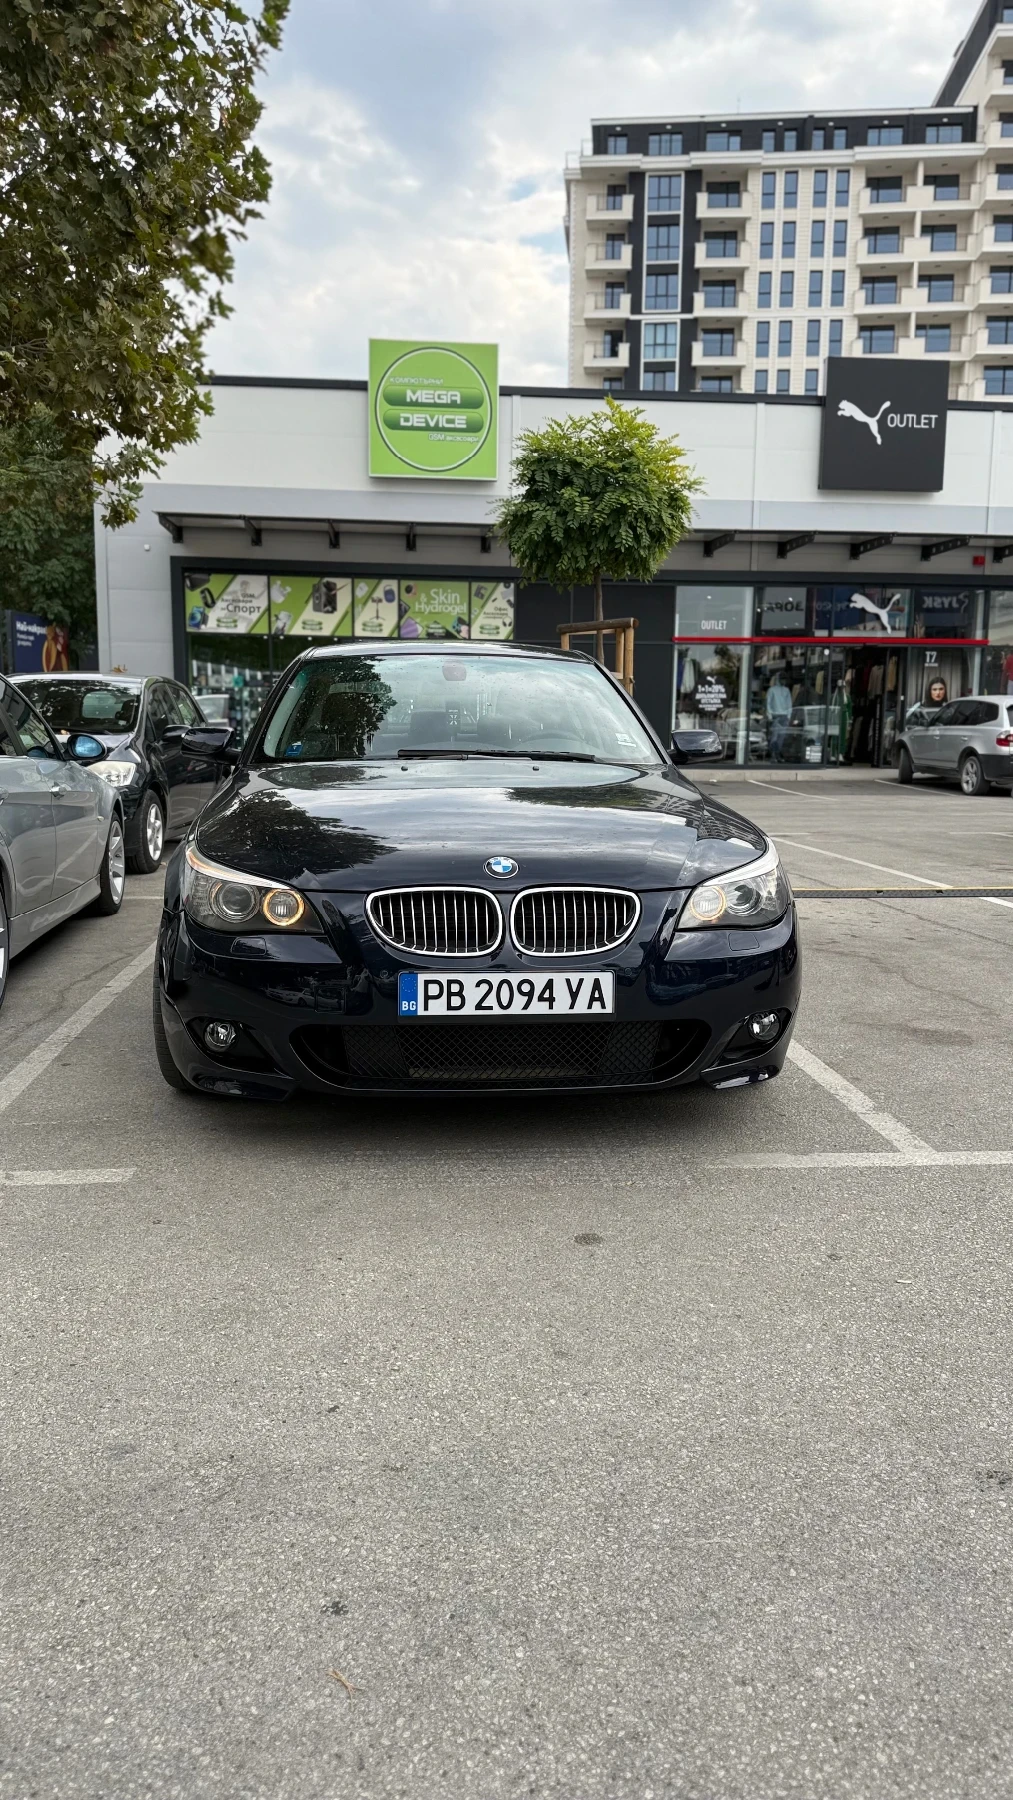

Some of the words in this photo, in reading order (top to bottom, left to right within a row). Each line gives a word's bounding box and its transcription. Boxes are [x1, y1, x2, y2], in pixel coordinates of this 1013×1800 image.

[406, 389, 461, 404] MEGA
[400, 413, 467, 428] DEVICE
[887, 413, 939, 429] OUTLET
[428, 433, 445, 441] GSM
[420, 593, 427, 602] &
[430, 588, 460, 604] Skin
[226, 603, 262, 615] Спорт
[415, 602, 467, 615] Hydrogel
[700, 620, 727, 630] OUTLET
[925, 651, 937, 663] T7
[423, 979, 466, 1011] PB
[475, 978, 556, 1011] 2094
[565, 977, 606, 1010] YA
[402, 1001, 417, 1011] BG
